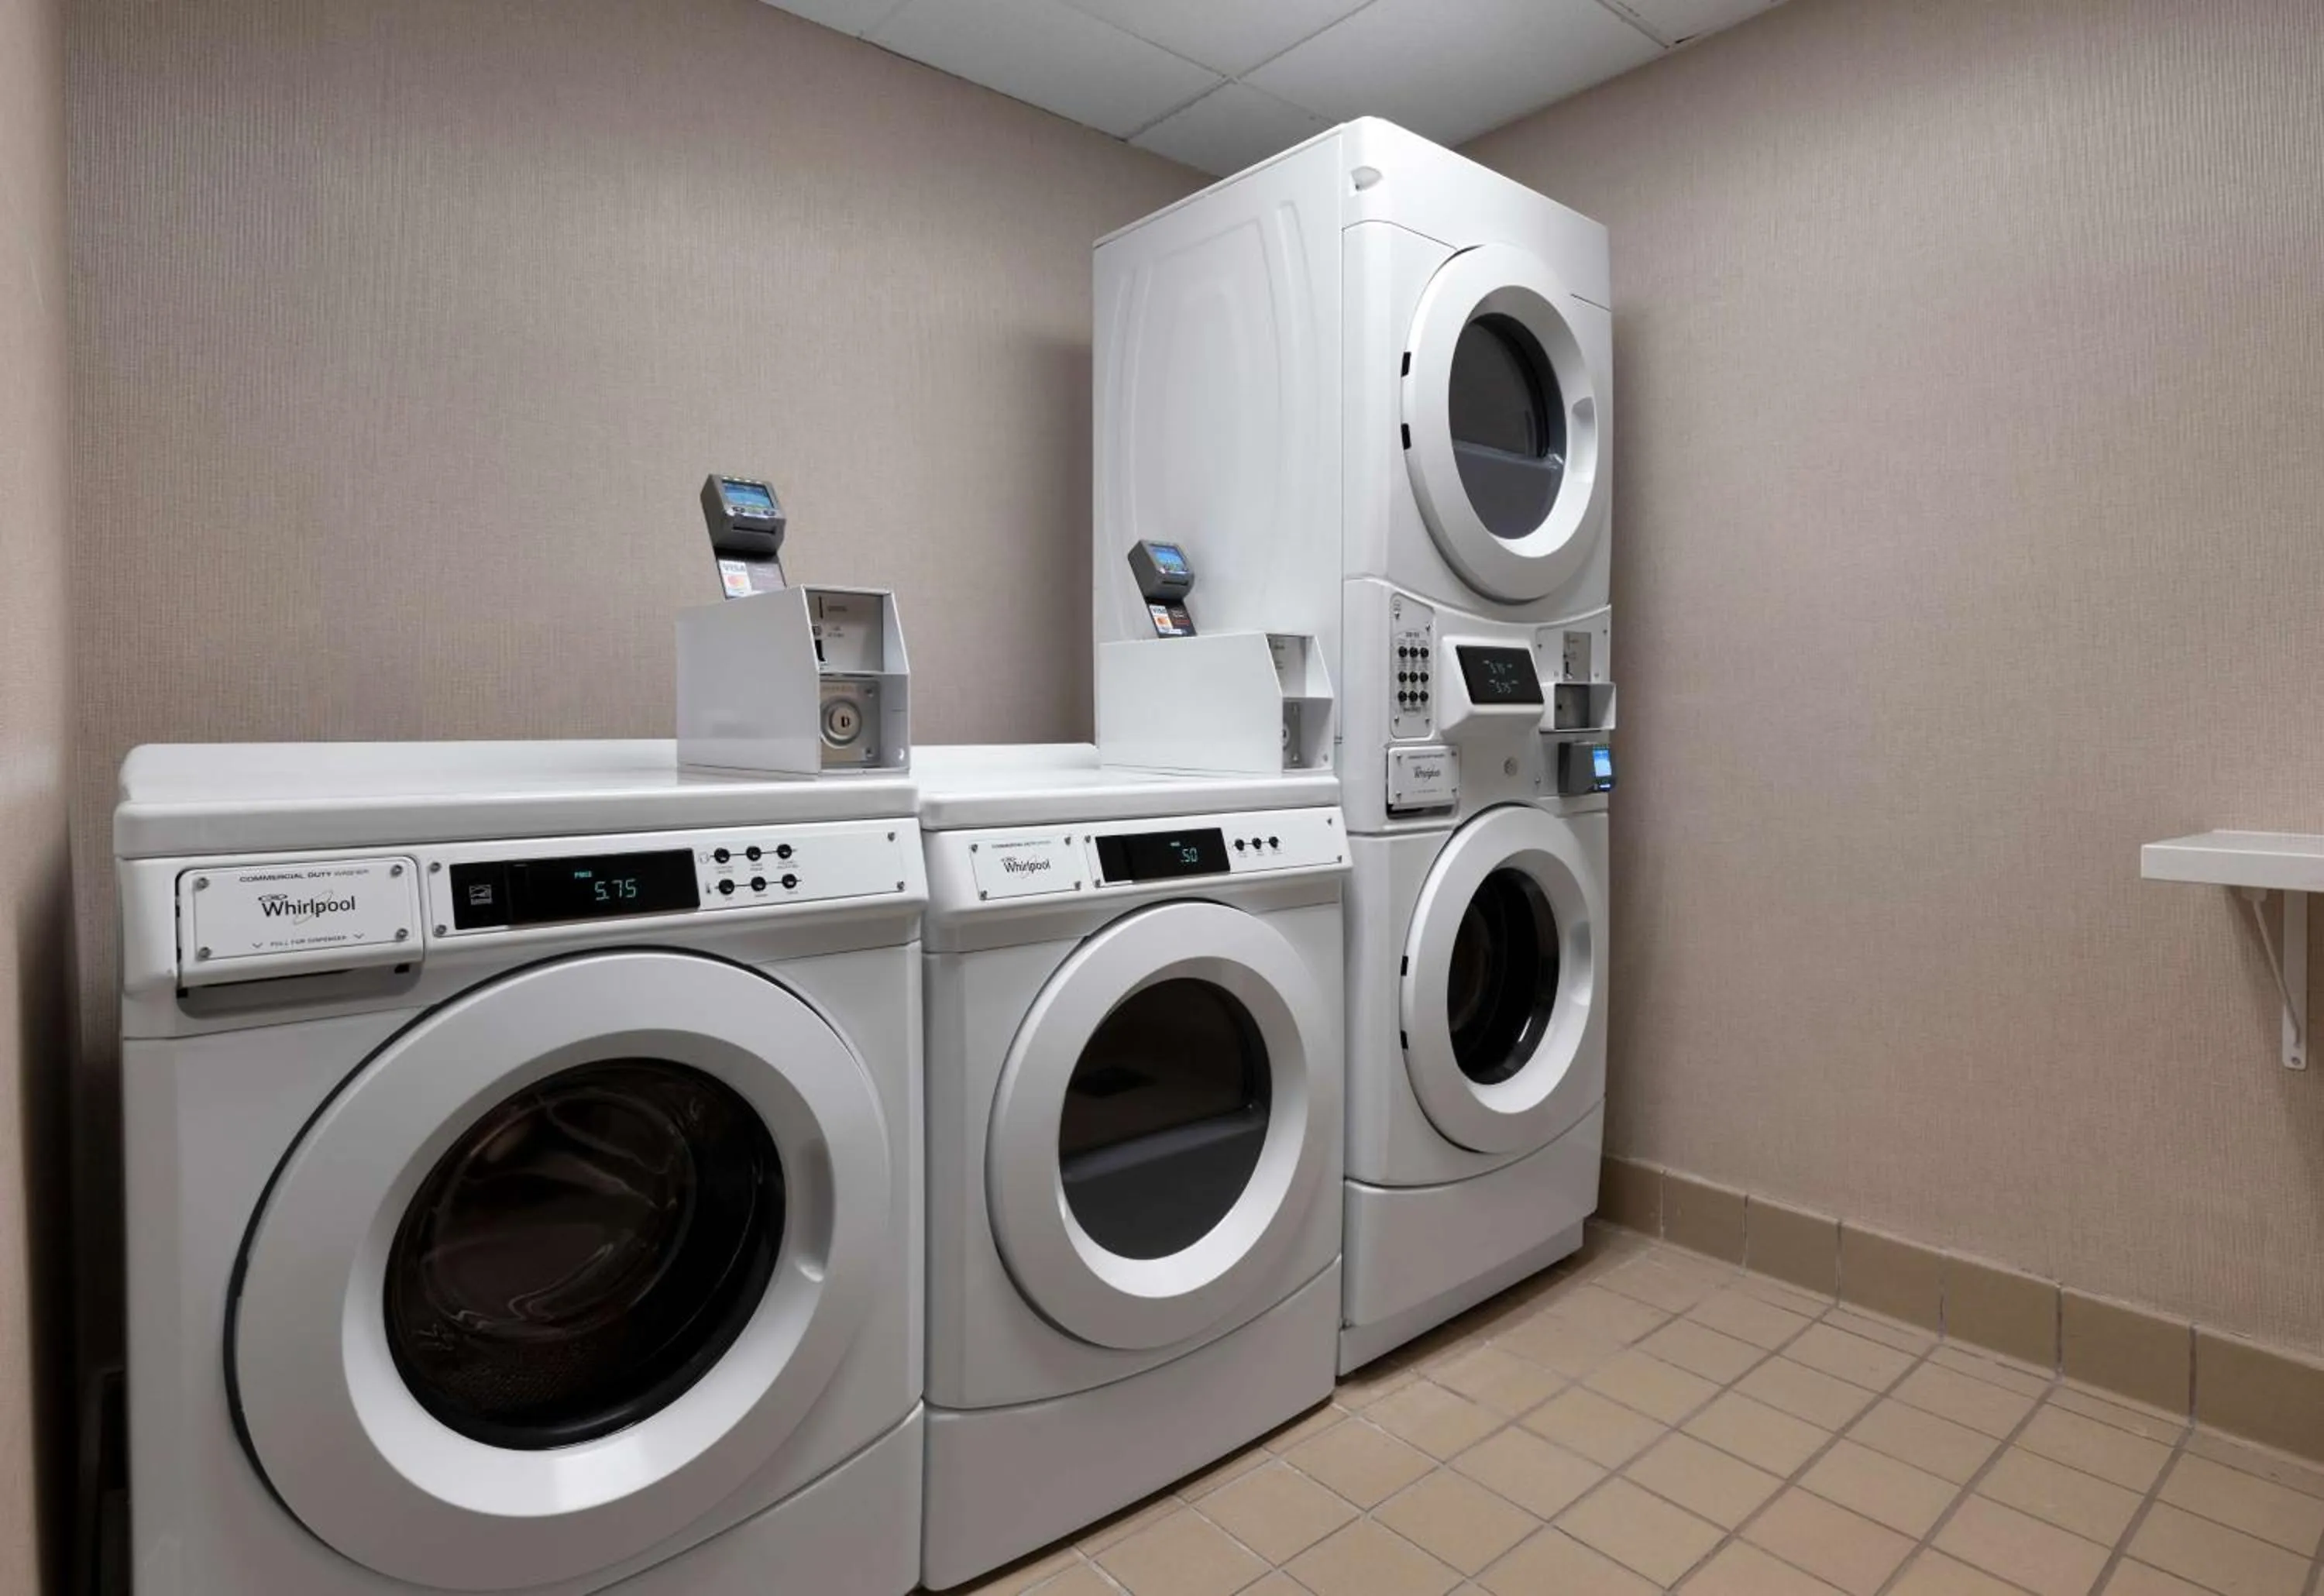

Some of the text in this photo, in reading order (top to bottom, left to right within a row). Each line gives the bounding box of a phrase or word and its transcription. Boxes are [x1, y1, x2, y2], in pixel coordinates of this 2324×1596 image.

[1003, 858, 1051, 874] Whirlpool
[239, 872, 305, 882] COMMERCIAL
[261, 895, 356, 918] Whirlpool
